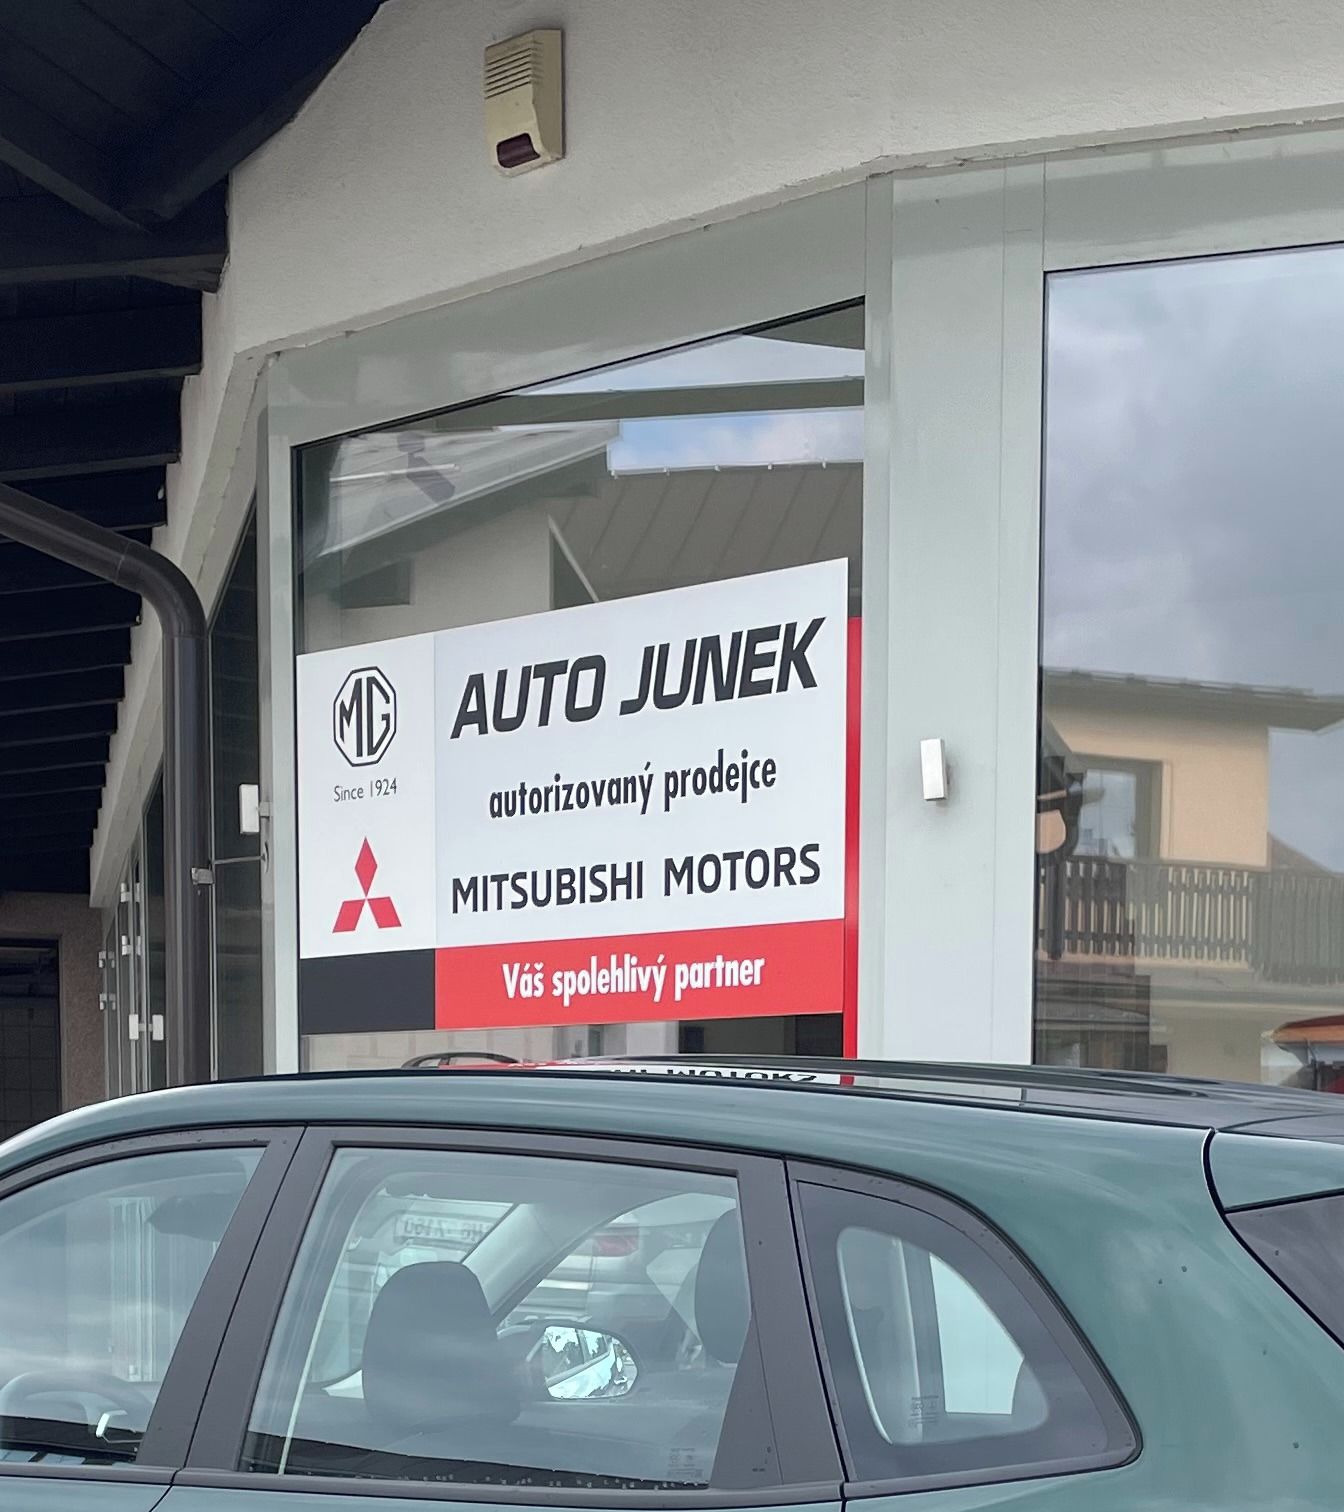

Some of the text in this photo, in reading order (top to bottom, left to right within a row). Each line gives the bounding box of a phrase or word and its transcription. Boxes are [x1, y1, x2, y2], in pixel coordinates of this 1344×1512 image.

[450, 616, 826, 739] AUTO JUNEK
[339, 675, 391, 758] MG
[333, 778, 397, 802] Since 1924
[489, 749, 777, 818] autorizovaný prodejce
[452, 843, 821, 914] MITSUBISHI MOTORS
[502, 953, 765, 1007] Váš spolehlivý partner
